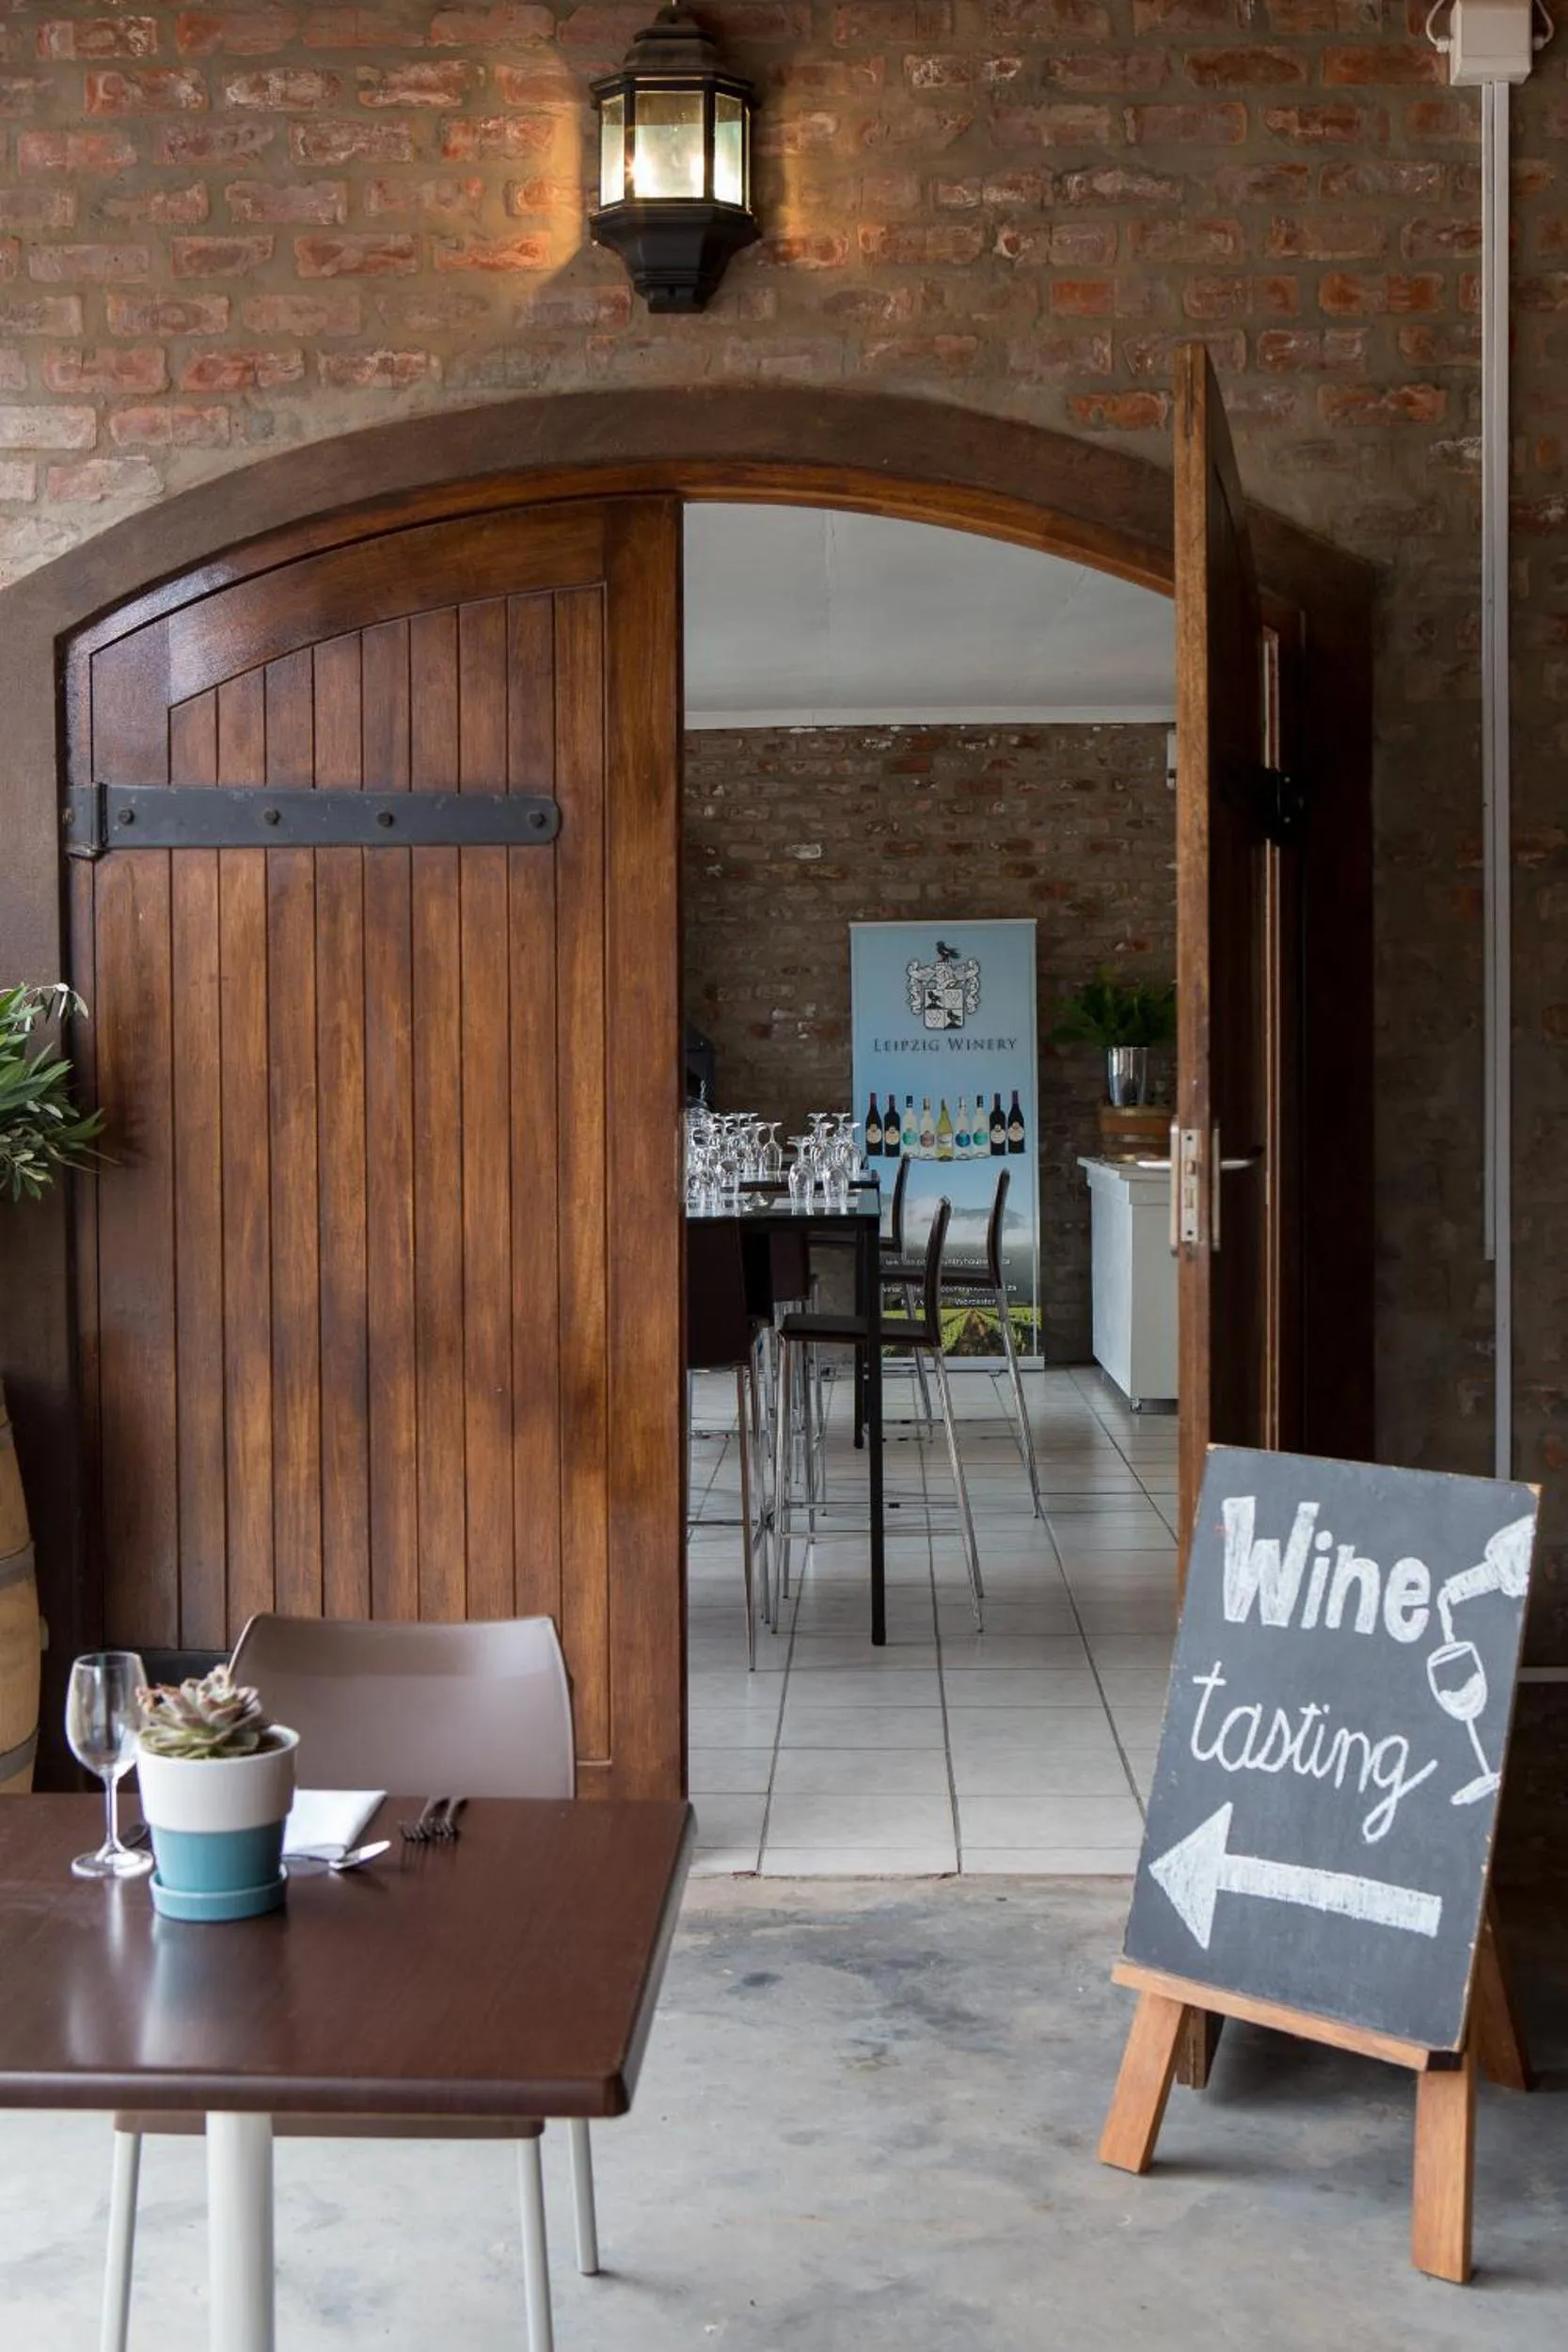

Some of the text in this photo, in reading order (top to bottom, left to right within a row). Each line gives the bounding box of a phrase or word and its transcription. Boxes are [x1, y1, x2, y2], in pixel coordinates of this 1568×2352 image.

[873, 1037, 1017, 1052] LEIPZIG WINERY
[1222, 1495, 1430, 1643] Wine
[1190, 1661, 1438, 1844] tasting
